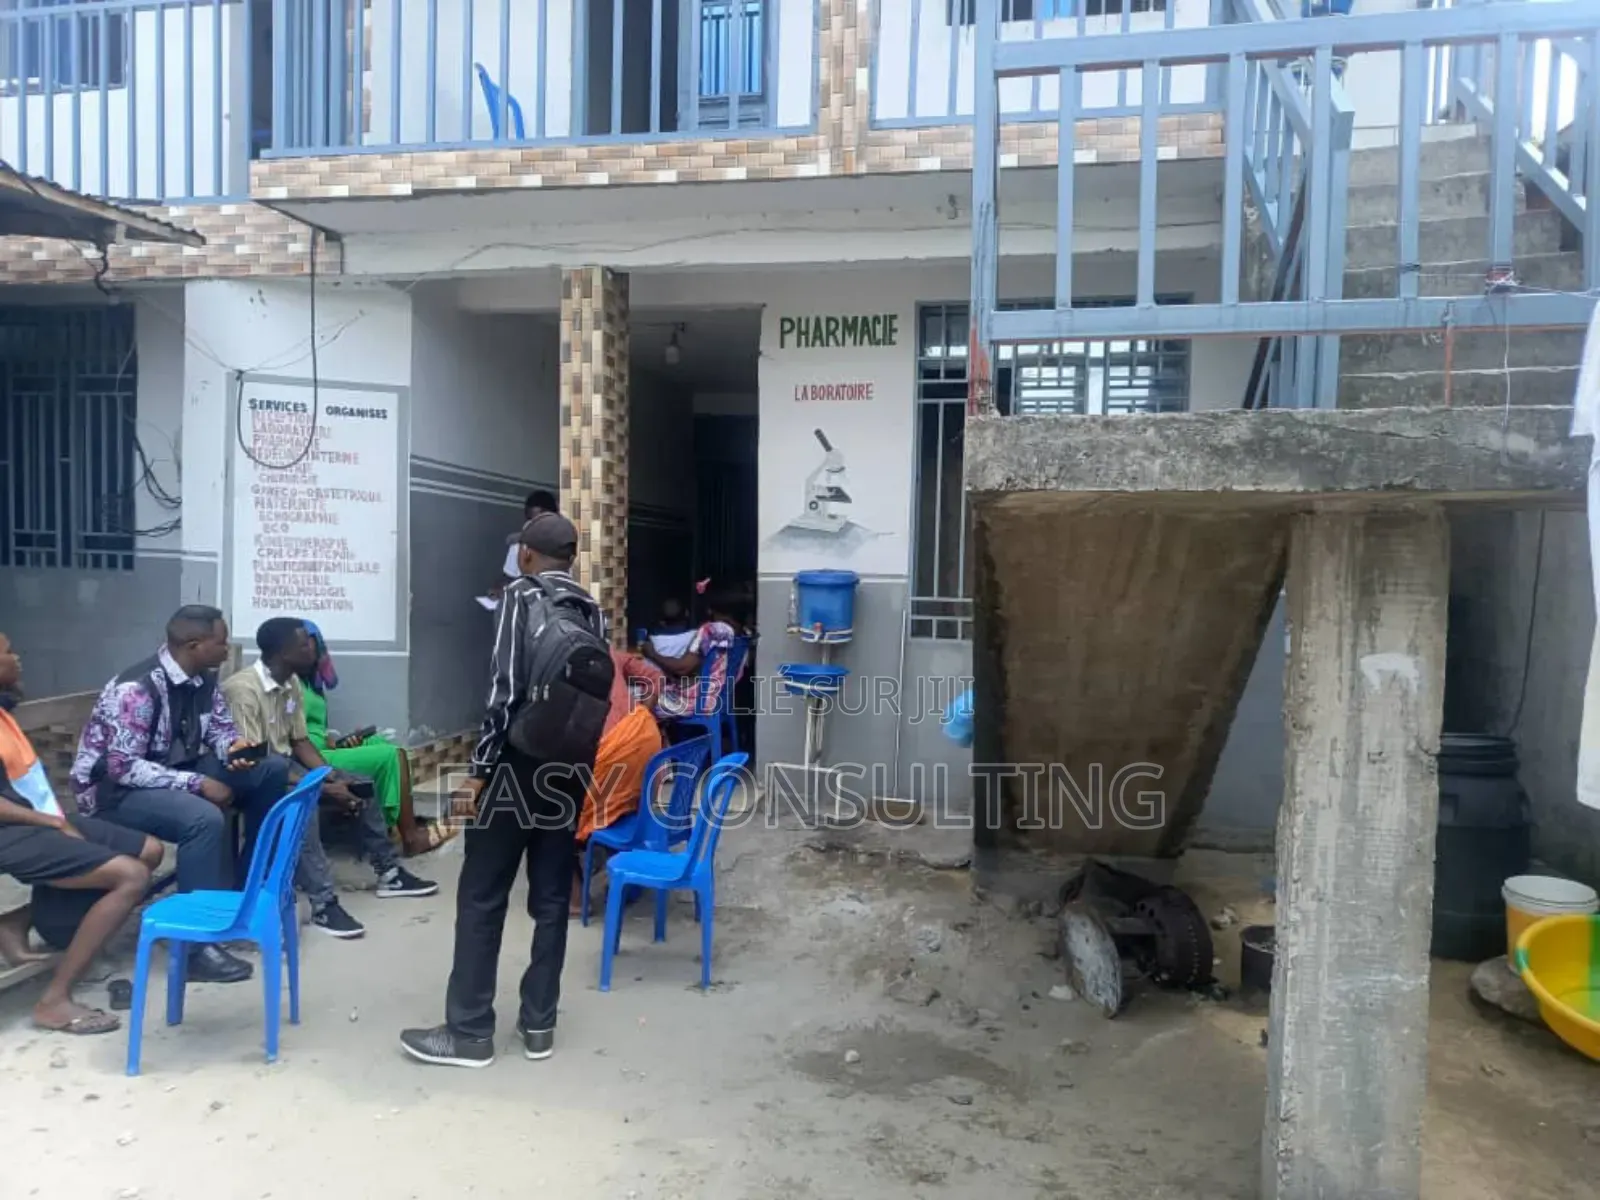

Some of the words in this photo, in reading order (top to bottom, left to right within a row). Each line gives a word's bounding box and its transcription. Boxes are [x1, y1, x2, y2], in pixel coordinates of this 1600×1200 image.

[780, 314, 898, 349] PHARMACIE
[794, 383, 874, 401] LABORATOIRE
[247, 398, 308, 413] SERVICES
[325, 405, 388, 420] ORGANISES
[251, 596, 354, 612] HOSPITALISATION
